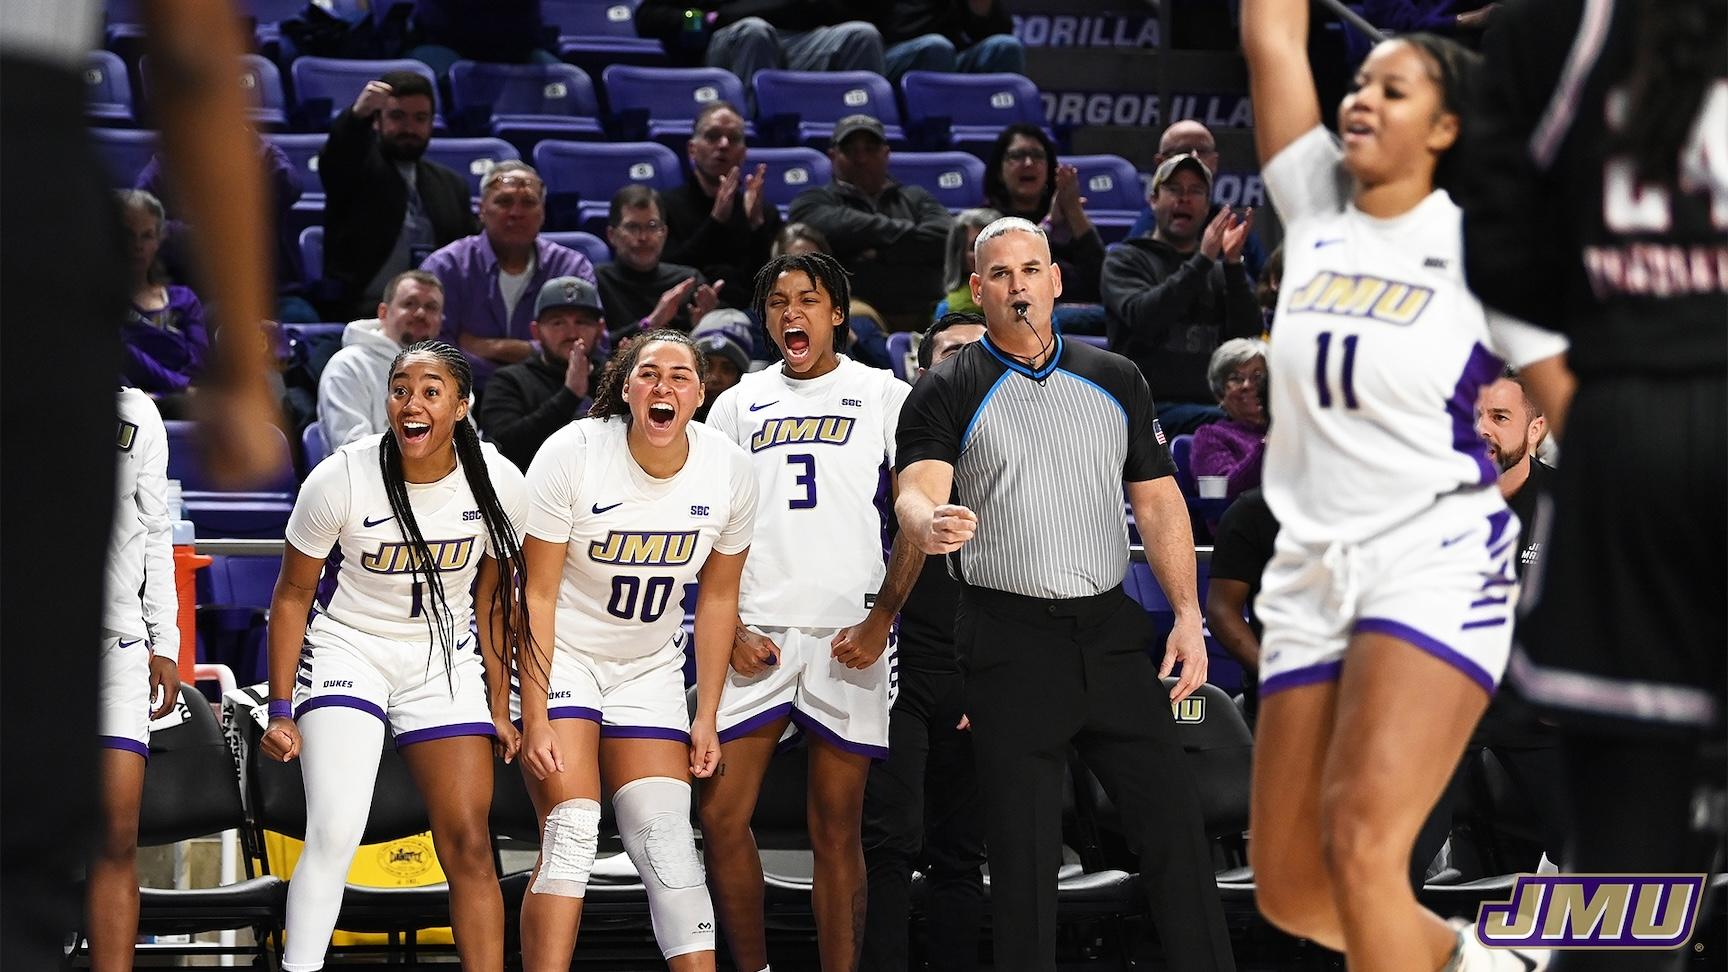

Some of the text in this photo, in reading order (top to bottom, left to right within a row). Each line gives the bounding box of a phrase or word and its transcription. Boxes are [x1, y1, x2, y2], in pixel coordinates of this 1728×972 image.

[1287, 270, 1434, 326] JMU
[1314, 331, 1359, 409] 11
[841, 398, 862, 407] SBC
[751, 415, 855, 453] JMU
[786, 453, 817, 510] 3
[690, 505, 710, 516] SBC
[361, 538, 475, 574] JMU
[589, 531, 699, 566] JMU
[409, 582, 426, 617] 1
[606, 575, 675, 622] 00
[323, 680, 353, 688] DUKES
